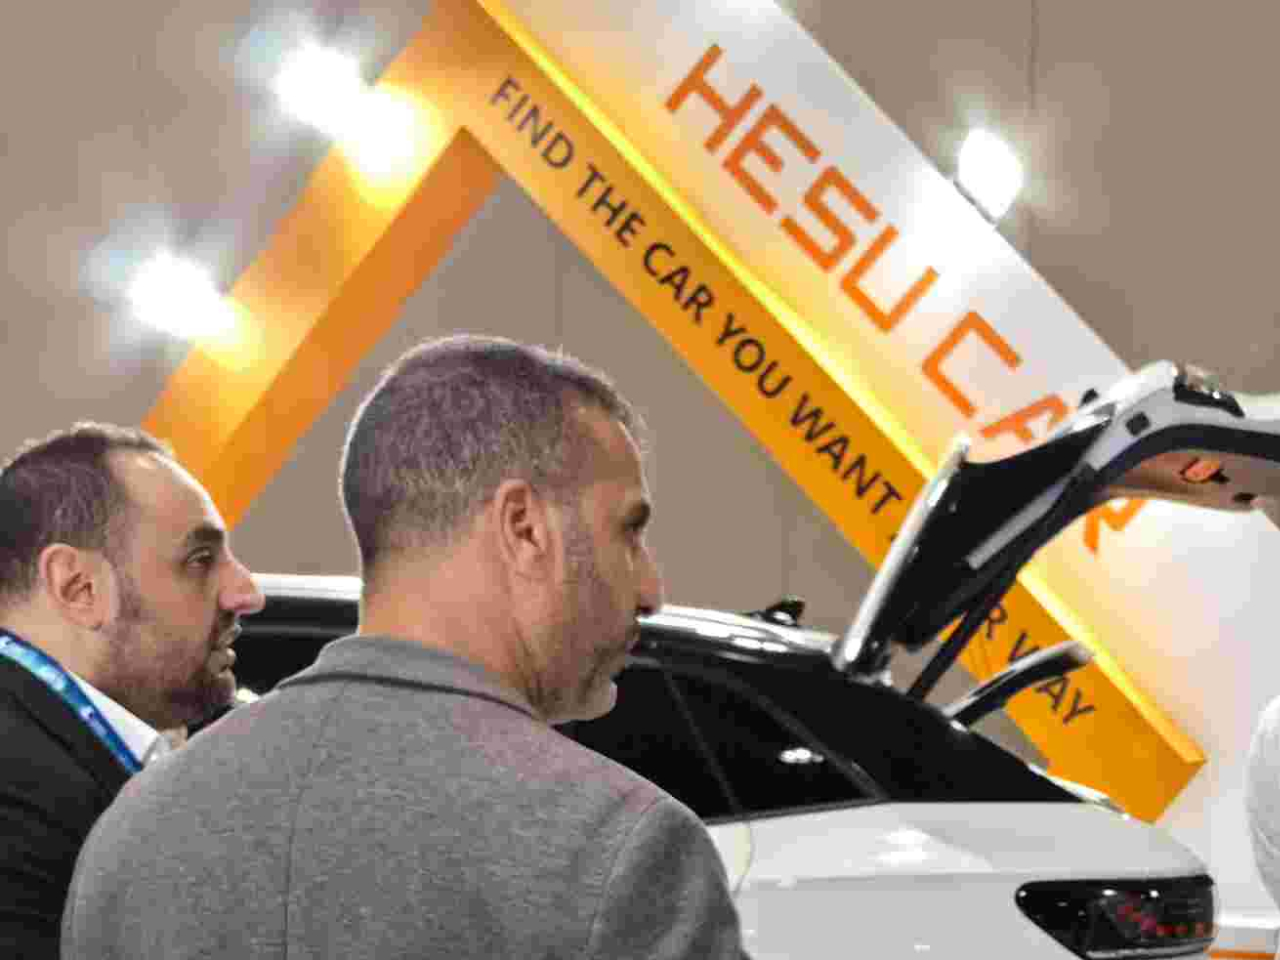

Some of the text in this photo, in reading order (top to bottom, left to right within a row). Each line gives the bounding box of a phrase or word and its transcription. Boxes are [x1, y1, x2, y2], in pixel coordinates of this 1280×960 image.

[488, 77, 575, 170] FIND
[575, 164, 647, 249] THE
[642, 241, 716, 325] CAR
[714, 312, 793, 400] YOU
[788, 392, 903, 516] WANT
[663, 44, 938, 333] HESU
